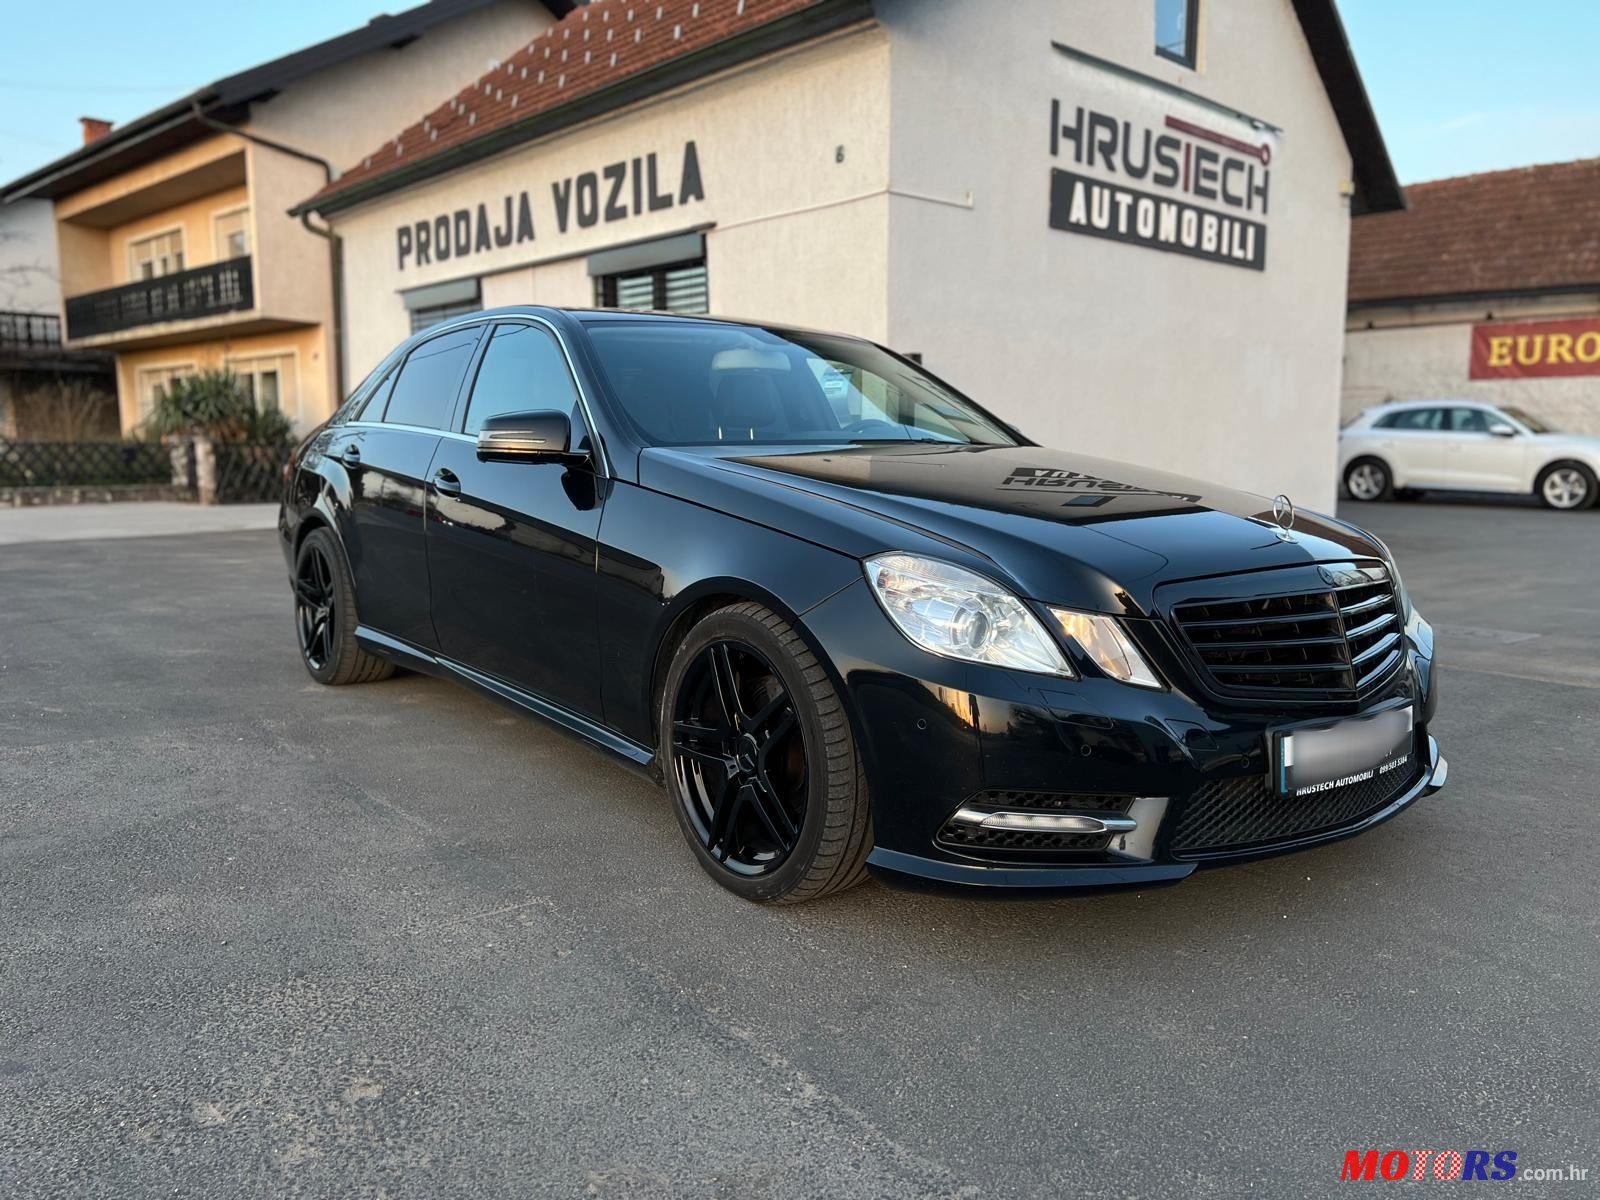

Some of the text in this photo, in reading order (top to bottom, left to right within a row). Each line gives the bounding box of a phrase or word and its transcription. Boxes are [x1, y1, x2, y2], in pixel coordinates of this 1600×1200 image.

[1050, 99, 1270, 215] HRUSTECH
[397, 140, 705, 271] PRODAJA VOZILA
[1069, 181, 1255, 262] AUTOMOBILI
[1488, 331, 1600, 367] EURO
[1296, 779, 1334, 796] HRUSTECH
[1335, 769, 1374, 787] AUTOMOBILI
